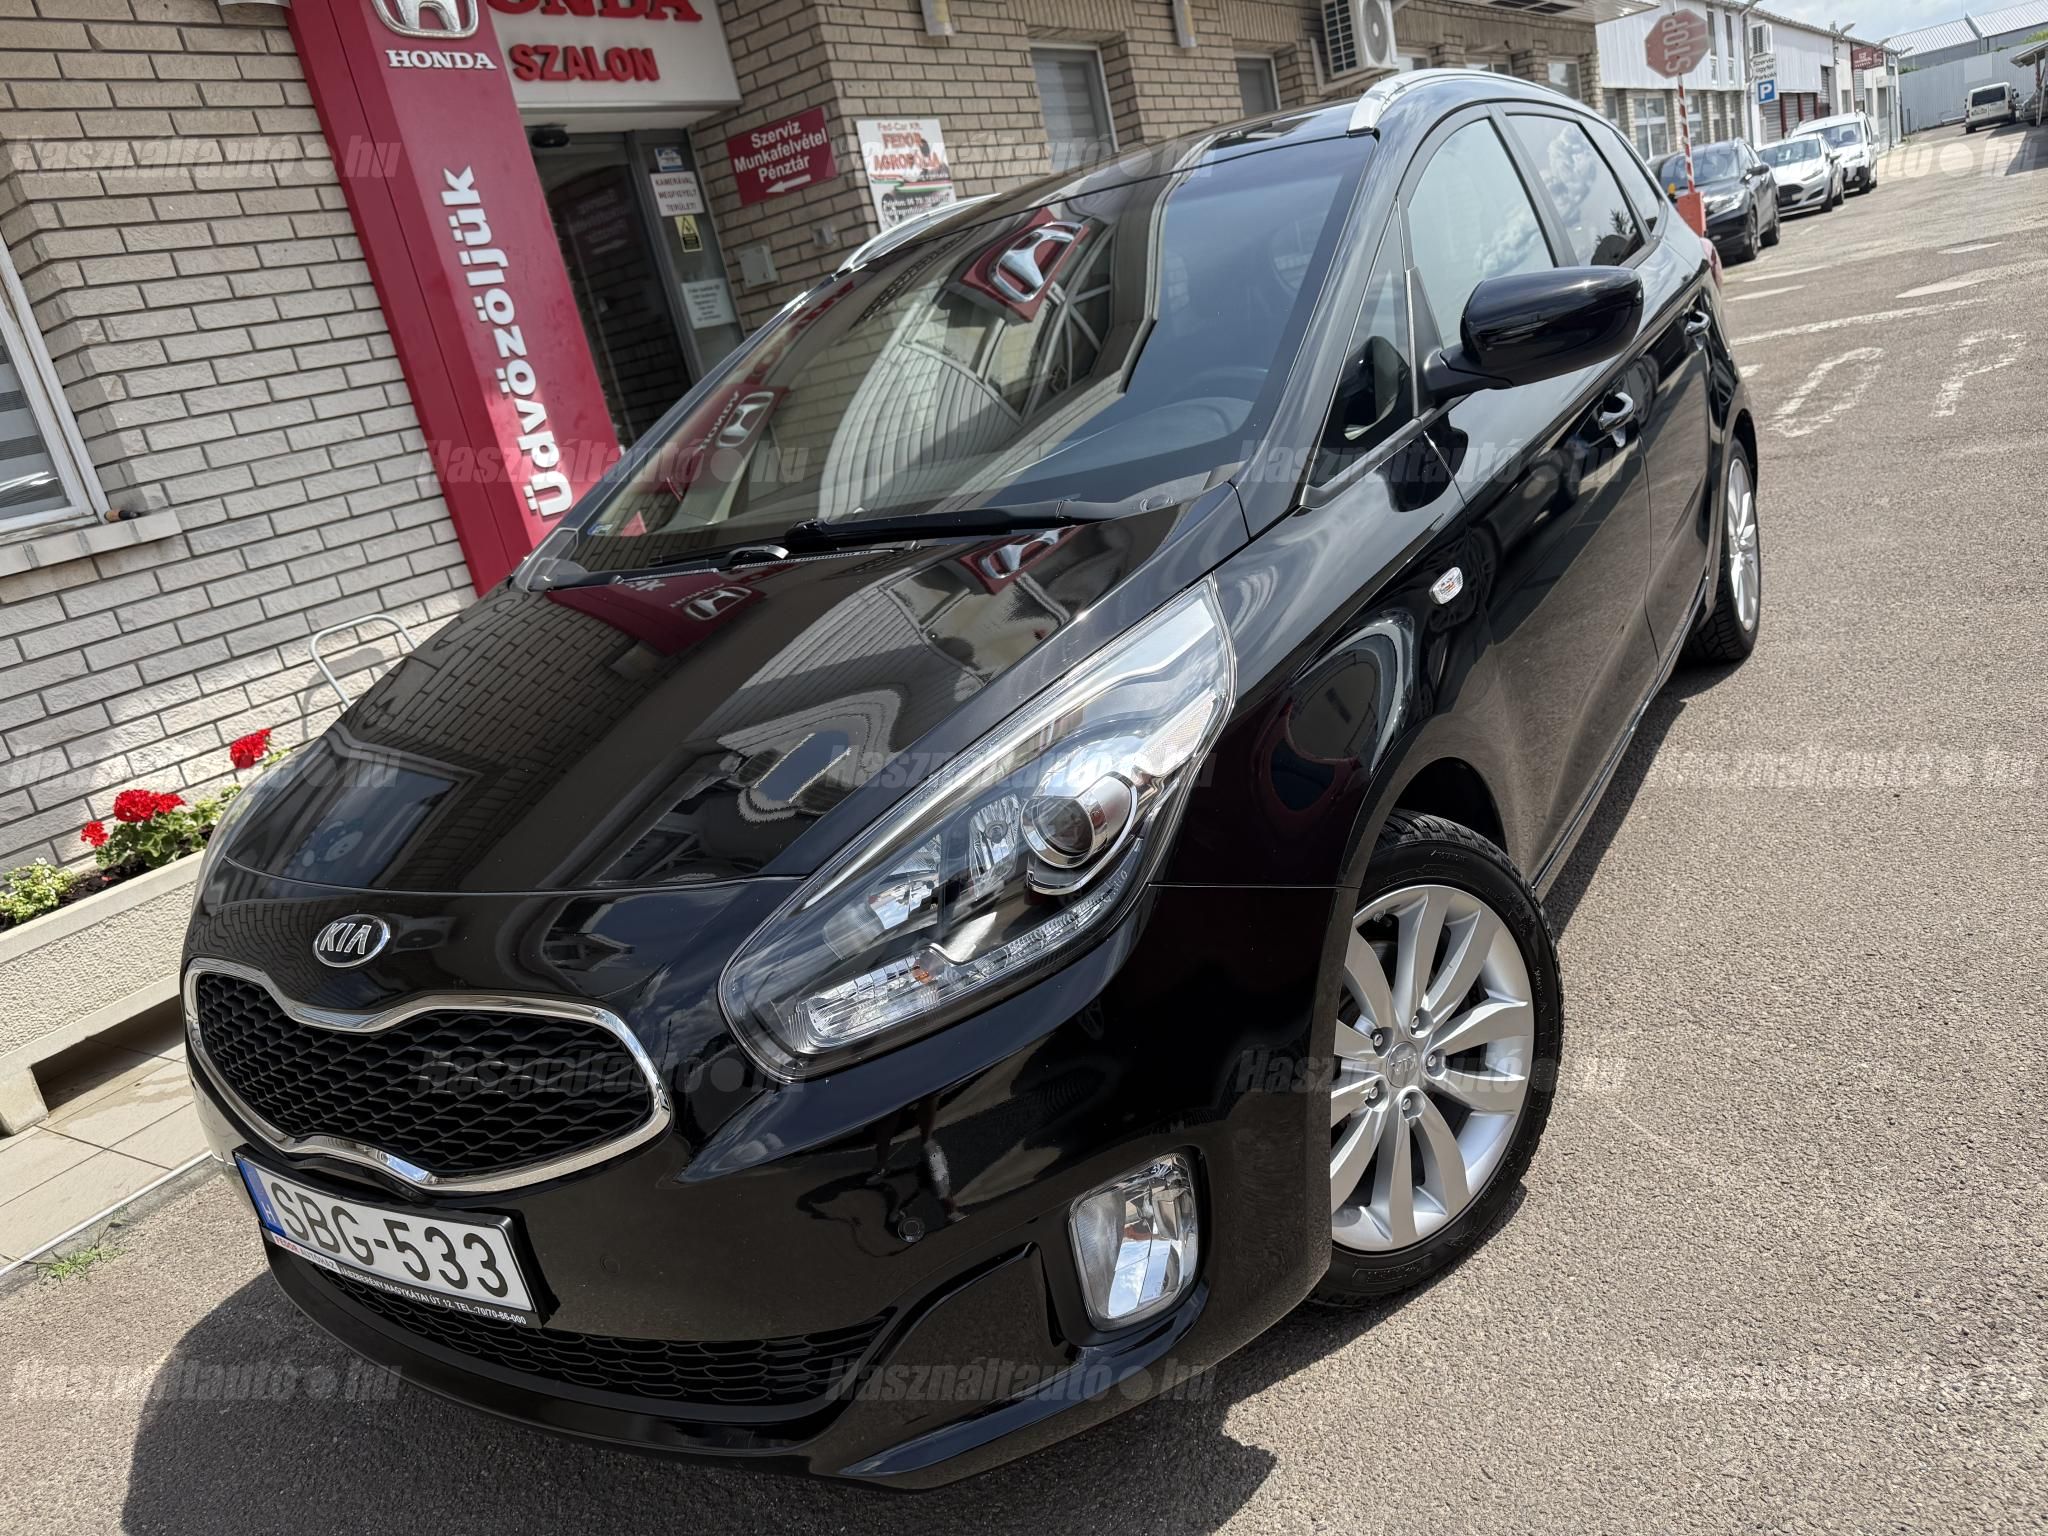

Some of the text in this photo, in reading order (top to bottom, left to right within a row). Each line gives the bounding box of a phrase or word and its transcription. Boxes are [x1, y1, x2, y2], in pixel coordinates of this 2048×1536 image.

[386, 50, 497, 69] HONDA
[1661, 18, 1692, 73] STOP
[510, 44, 660, 82] SZALON
[1760, 83, 1773, 100] P
[734, 127, 828, 173] Munkafelvétel
[751, 120, 802, 149] Szerviz
[881, 132, 924, 149] FEDOR
[758, 154, 811, 183] Pénztár
[441, 165, 573, 518] Üdvözöljük
[319, 922, 372, 955] KIA
[271, 1181, 509, 1299] SBG-533
